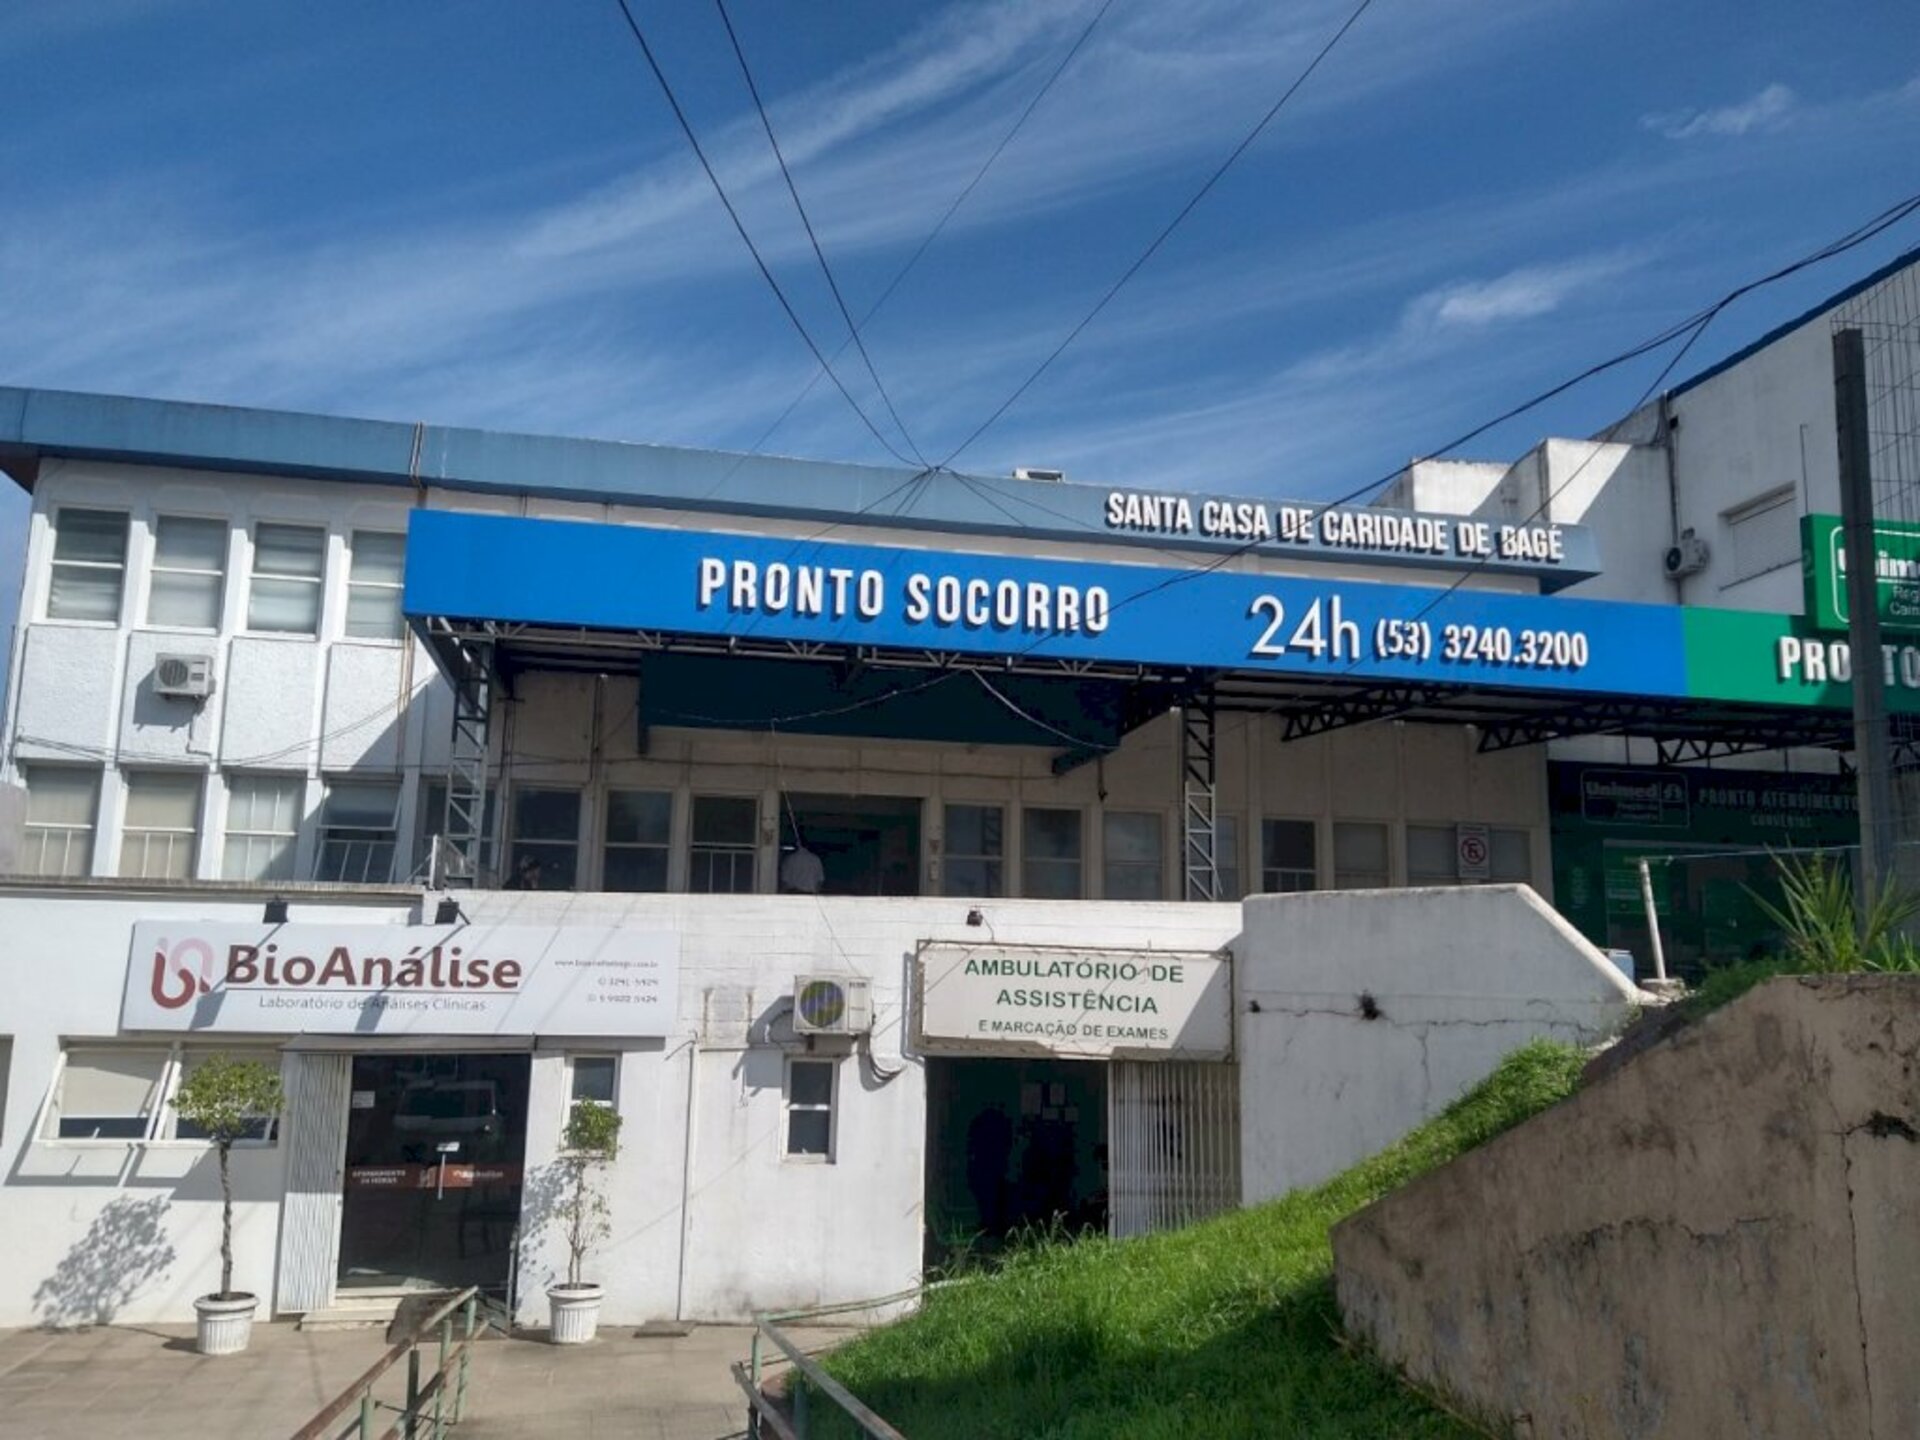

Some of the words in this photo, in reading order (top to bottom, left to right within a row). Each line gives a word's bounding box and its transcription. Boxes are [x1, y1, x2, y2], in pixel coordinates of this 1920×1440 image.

[1107, 491, 1192, 531] SANTA
[1201, 499, 1270, 537] CASA
[1280, 507, 1314, 540] DE
[1322, 511, 1449, 551] CARIDADE
[1459, 522, 1491, 555] DE
[1502, 522, 1564, 561] BAGÉ
[700, 557, 885, 618] PRONTO
[906, 573, 1110, 634] SOCORRO
[1248, 593, 1361, 660] 24h
[1374, 617, 1433, 660] (53)
[1442, 624, 1589, 668] 3240.3200
[1779, 636, 1920, 688] PROTO
[1585, 780, 1658, 799] Unimed
[1699, 788, 1756, 806] PRONTO
[225, 944, 523, 989] BioAnálise
[965, 959, 1137, 980] AMBULATÓRIO
[1152, 965, 1184, 983] DE
[259, 996, 343, 1009] Laboratório
[347, 999, 366, 1010] de
[371, 996, 429, 1011] Análises
[432, 998, 486, 1012] Clínicas
[996, 989, 1158, 1014] ASSISTÊNCIA
[979, 1020, 988, 1032] E
[992, 1020, 1077, 1036] MARCAÇÃO
[1083, 1025, 1103, 1037] DE
[1107, 1026, 1169, 1040] EXAMES
